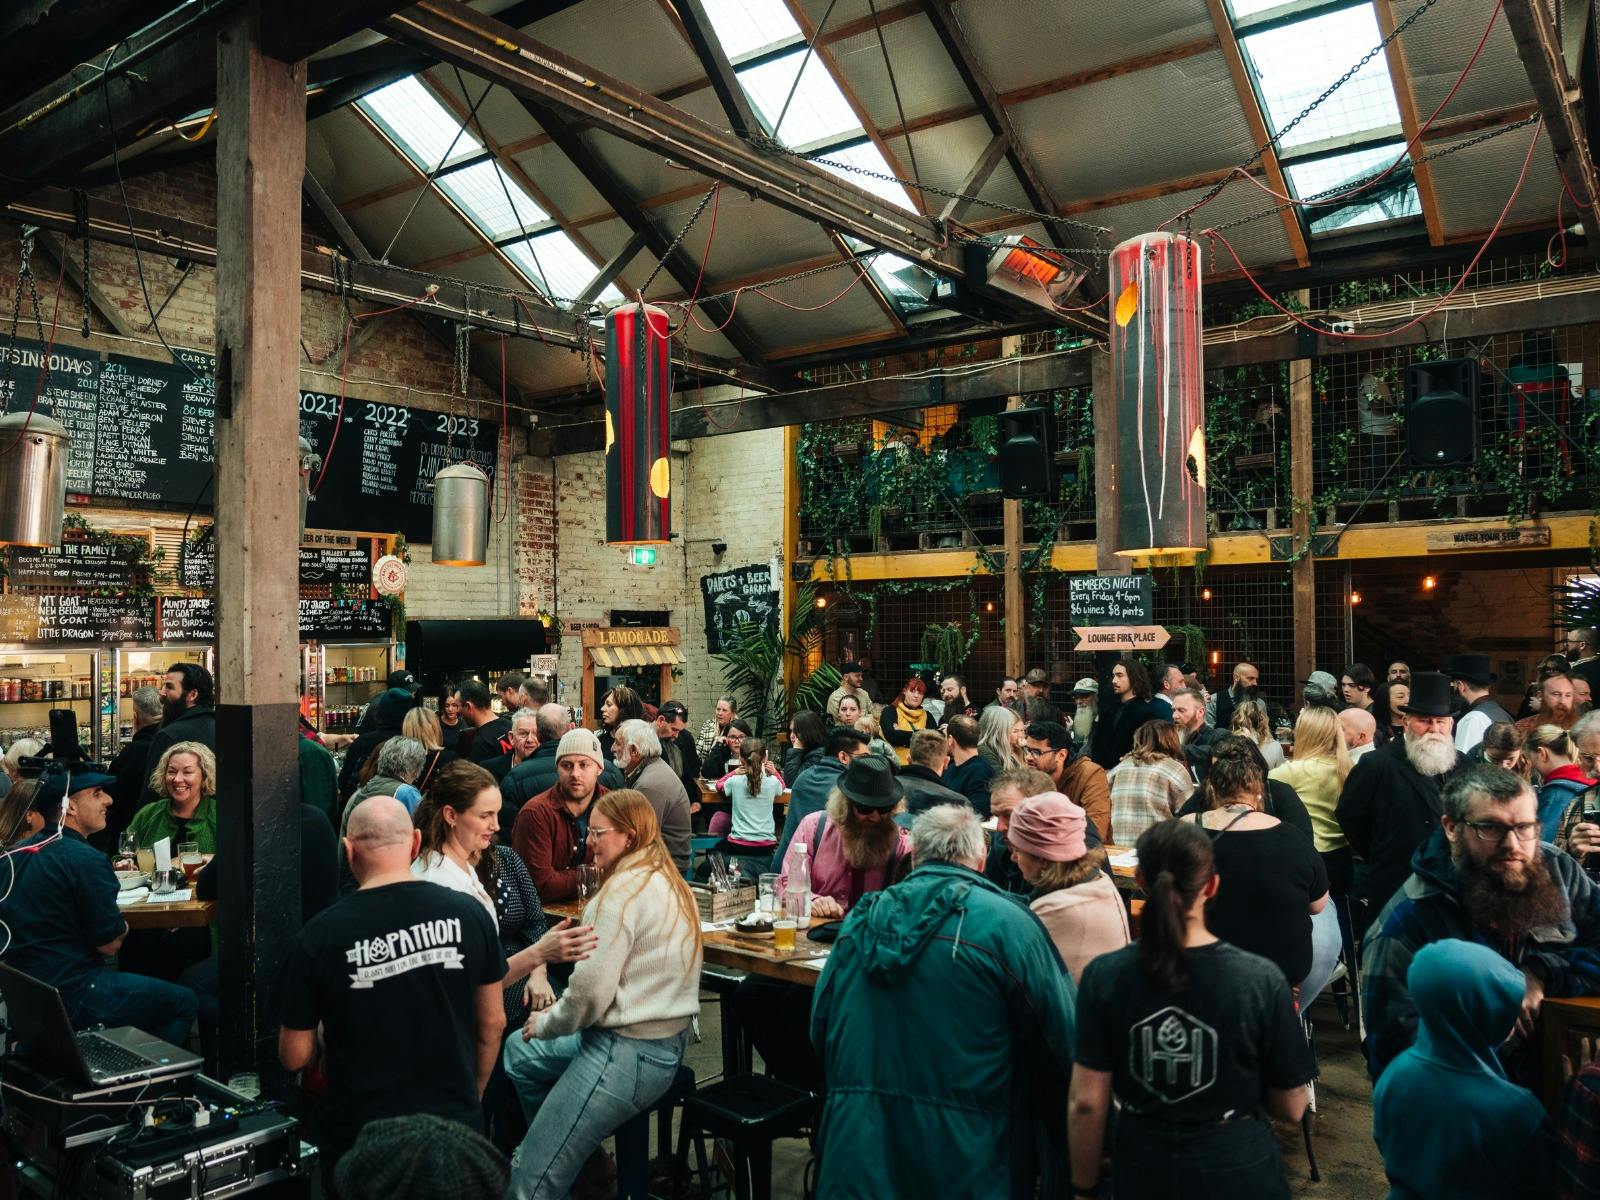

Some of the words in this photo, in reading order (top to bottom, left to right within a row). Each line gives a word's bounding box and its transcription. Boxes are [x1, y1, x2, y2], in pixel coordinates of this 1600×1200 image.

[181, 354, 206, 364] CARS
[61, 356, 92, 375] DAYS
[100, 380, 127, 389] STEVE
[100, 386, 119, 395] RYAN
[125, 390, 146, 400] BELL
[365, 403, 408, 428] 2022
[122, 426, 147, 435] PERRY
[437, 414, 479, 437] 2023
[133, 449, 158, 457] WHITE
[116, 461, 135, 469] BIRD
[118, 469, 147, 479] PORTER
[1453, 533, 1478, 542] WATCH
[64, 544, 79, 555] THE
[706, 575, 737, 594] DARTS
[746, 572, 771, 584] BEER
[1070, 578, 1110, 591] MEMBERS
[1112, 577, 1142, 589] NIGHT
[39, 595, 56, 607] MT
[59, 595, 80, 607] GOAT
[1071, 592, 1090, 603] Every
[1092, 591, 1115, 604] Friday
[1115, 591, 1140, 604] 4-6pm
[38, 606, 56, 616] NEW
[162, 609, 174, 618] MT
[175, 609, 195, 617] GOAT
[1070, 603, 1082, 615] $6
[1108, 604, 1120, 617] $8
[1122, 606, 1144, 618] pints
[39, 616, 57, 625] MT
[59, 616, 88, 625] GOAT
[37, 628, 60, 638] LITTLE
[62, 628, 94, 639] DRAGON
[600, 630, 669, 644] LEMONADE
[1088, 634, 1116, 643] LOUNGE
[1117, 634, 1132, 642] FIRE
[1134, 633, 1156, 642] PLACE
